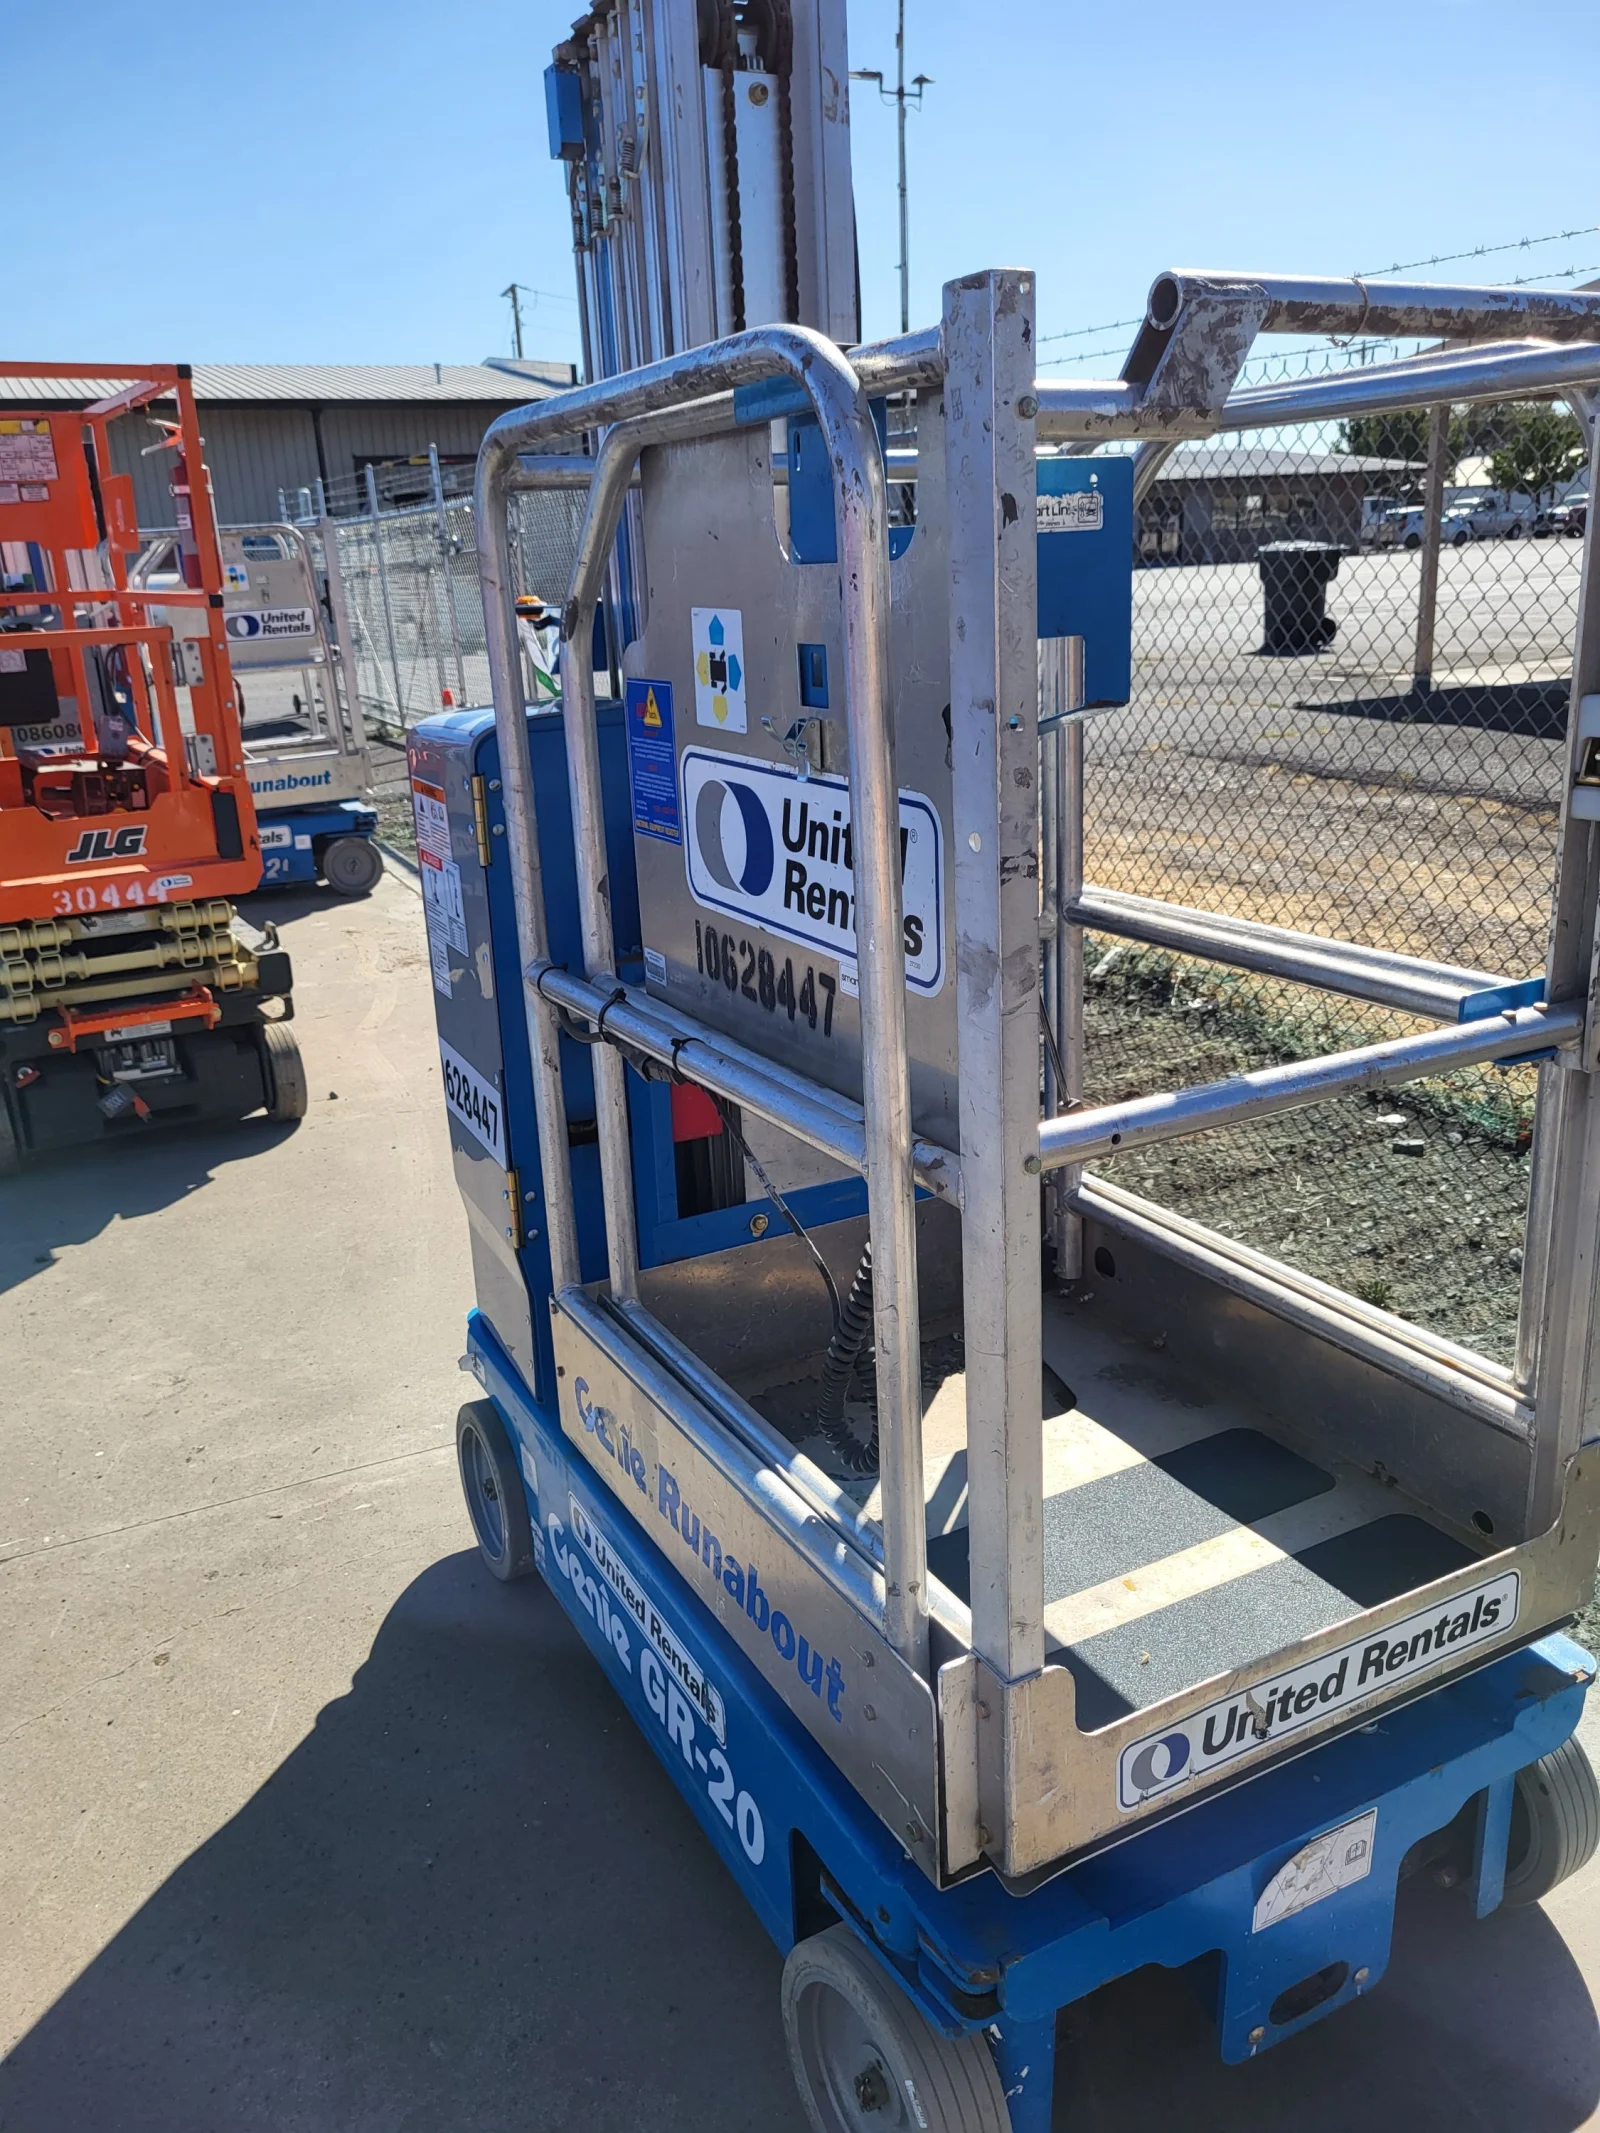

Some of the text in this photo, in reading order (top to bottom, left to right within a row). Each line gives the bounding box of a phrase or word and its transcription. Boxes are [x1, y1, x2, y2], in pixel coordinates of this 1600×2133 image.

[261, 610, 305, 624] United
[262, 622, 311, 635] Rentals
[12, 723, 82, 743] 08608
[251, 770, 331, 793] unabout
[67, 825, 147, 862] JLG
[52, 880, 168, 914] 30444
[783, 858, 924, 957] Rens
[695, 920, 836, 1037] 10628447
[445, 1058, 498, 1147] 628447
[595, 1539, 717, 1725] United Rentals
[658, 1463, 846, 1723] Runabout
[548, 1512, 765, 1866] Genie GR-20
[1201, 1594, 1502, 1757] United Rentals
